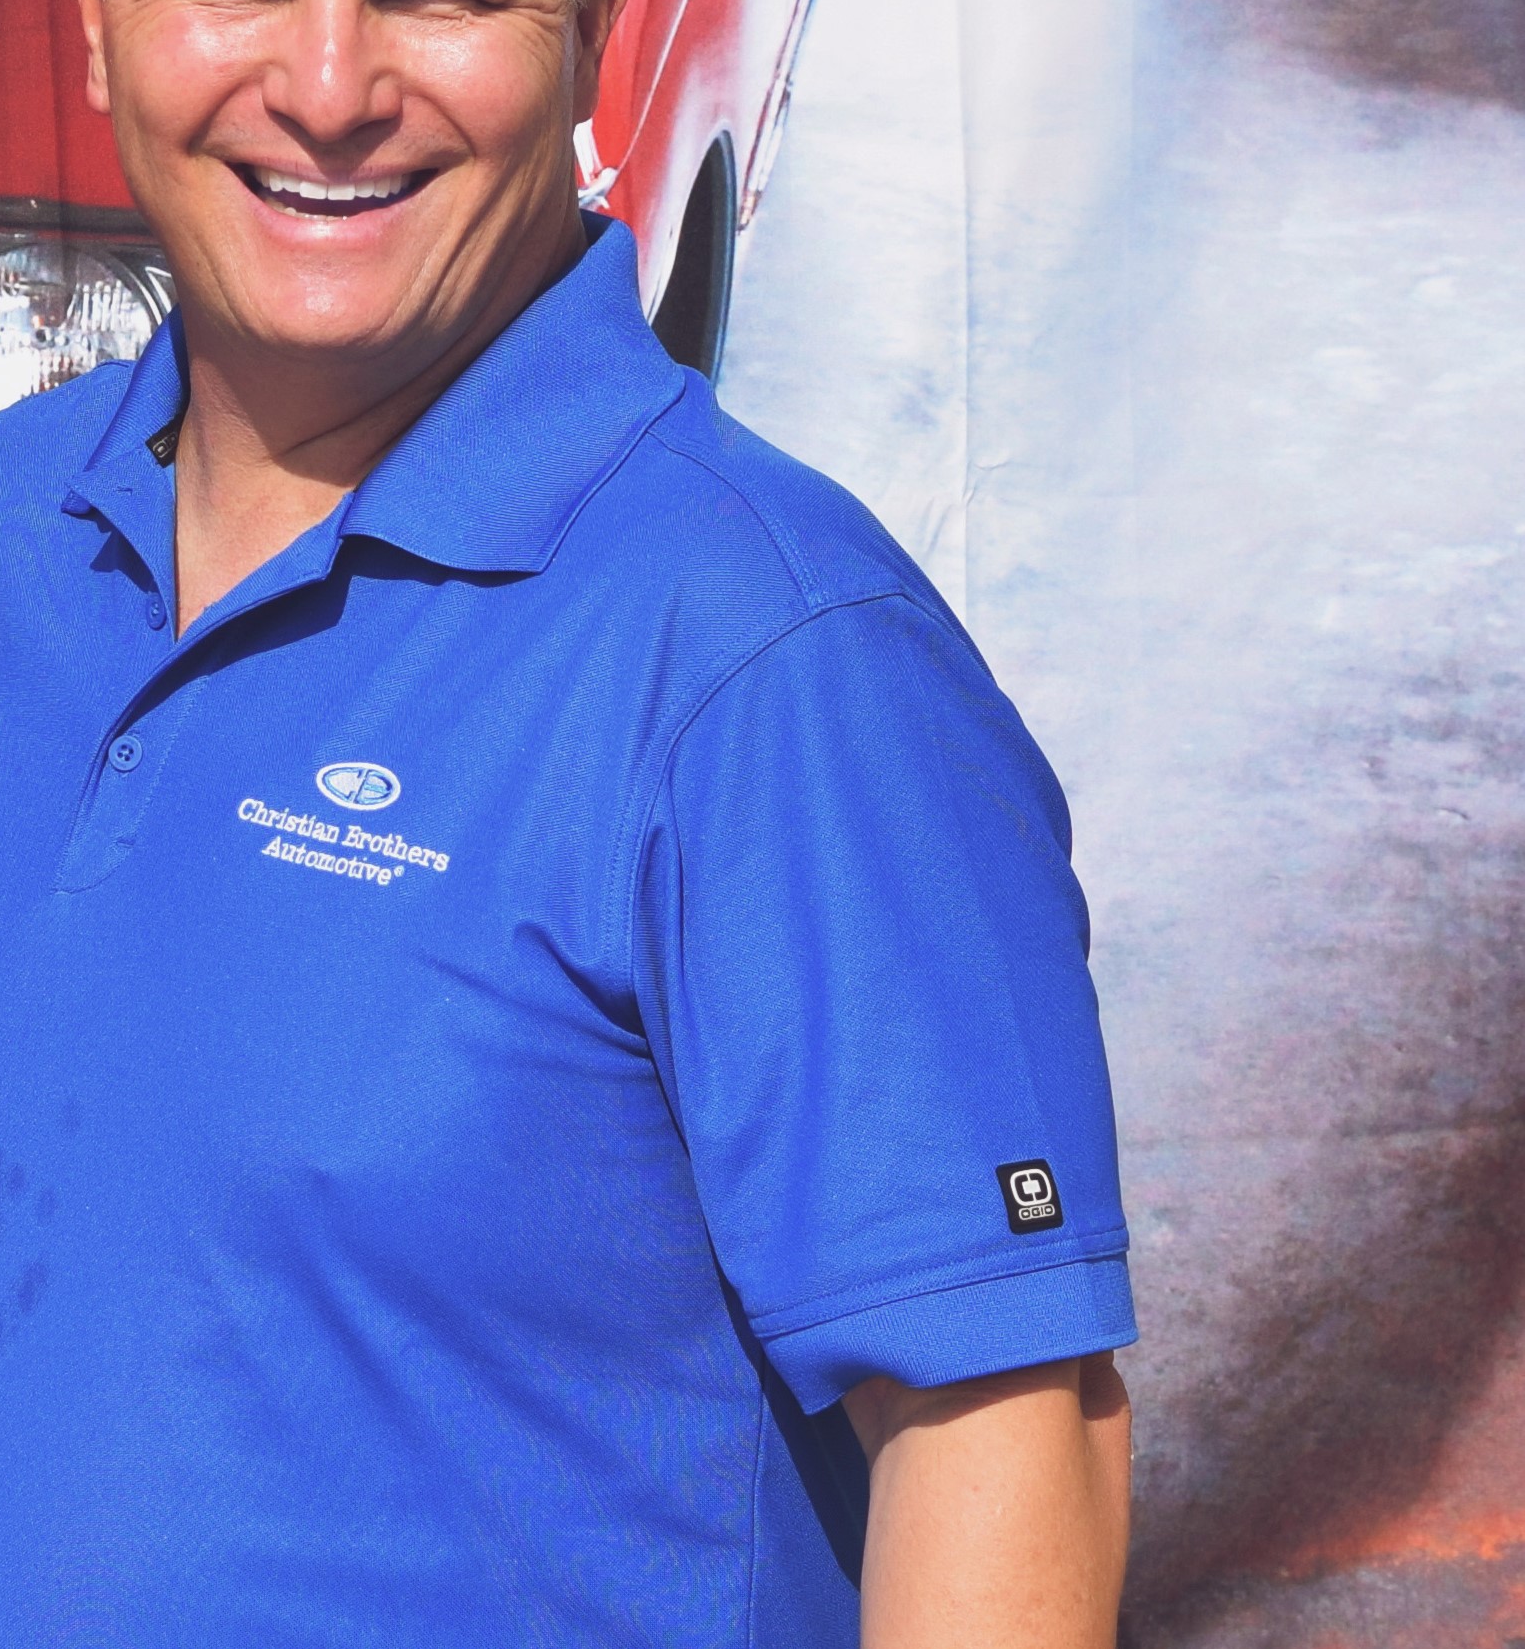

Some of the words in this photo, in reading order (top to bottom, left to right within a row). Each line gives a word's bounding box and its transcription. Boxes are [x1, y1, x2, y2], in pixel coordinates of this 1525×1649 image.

[237, 798, 340, 844] Christian
[341, 825, 450, 872] Brothers
[1019, 1204, 1055, 1220] OGIO
